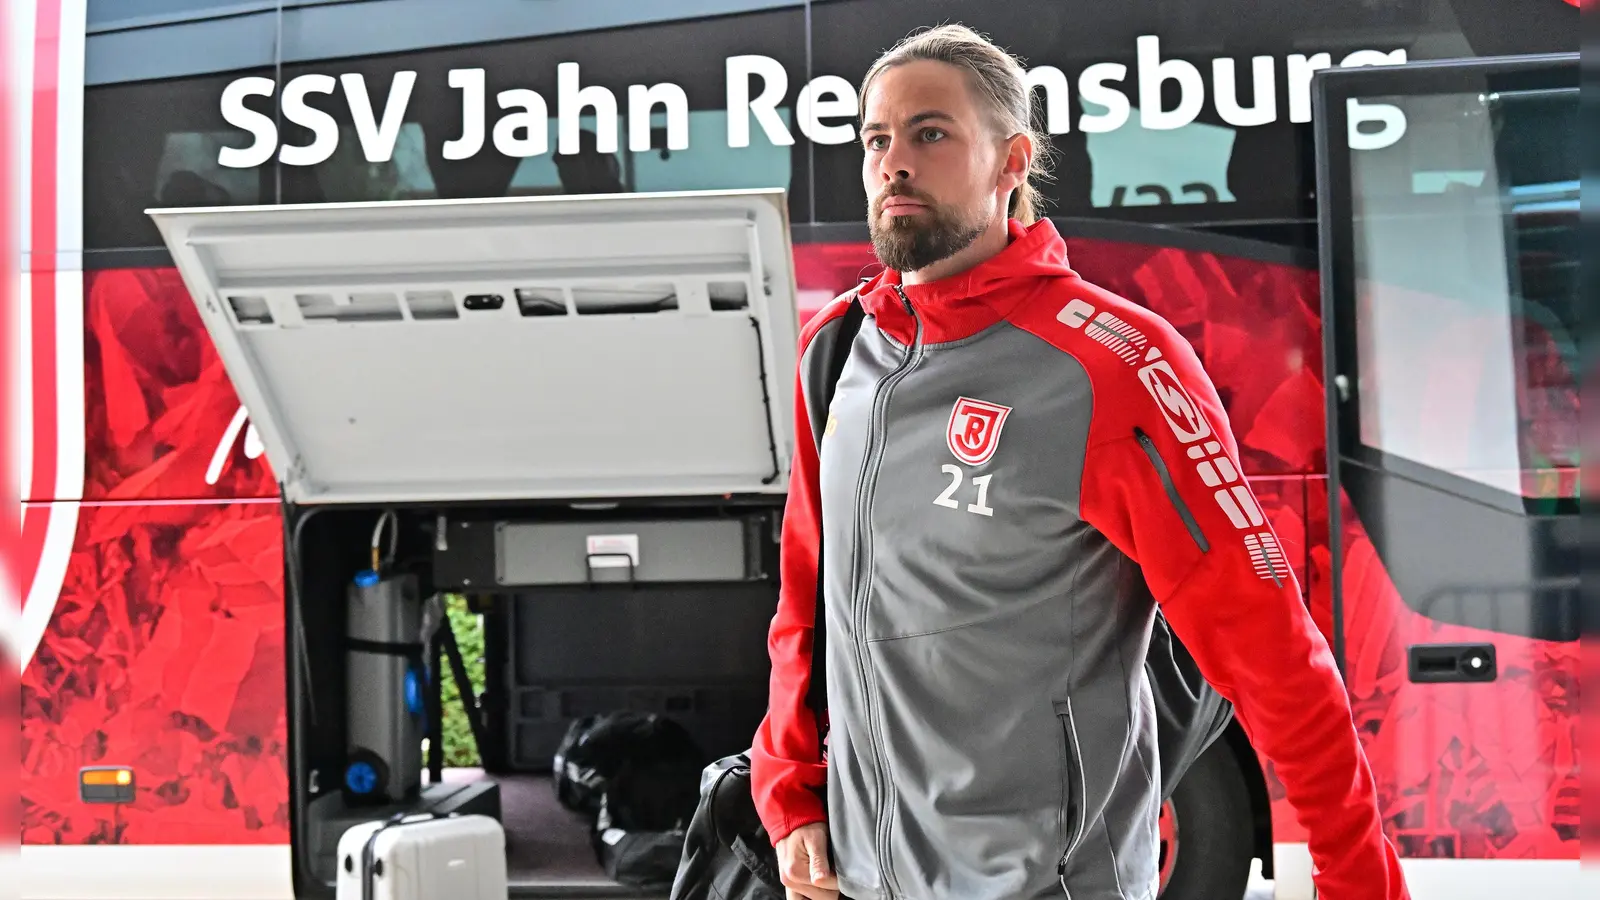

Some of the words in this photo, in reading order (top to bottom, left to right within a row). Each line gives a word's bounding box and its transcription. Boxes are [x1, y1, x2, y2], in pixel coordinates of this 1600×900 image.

[218, 70, 417, 168] SSV
[443, 62, 689, 160] Jahn
[726, 35, 1408, 150] Rensburg
[932, 463, 994, 517] 21
